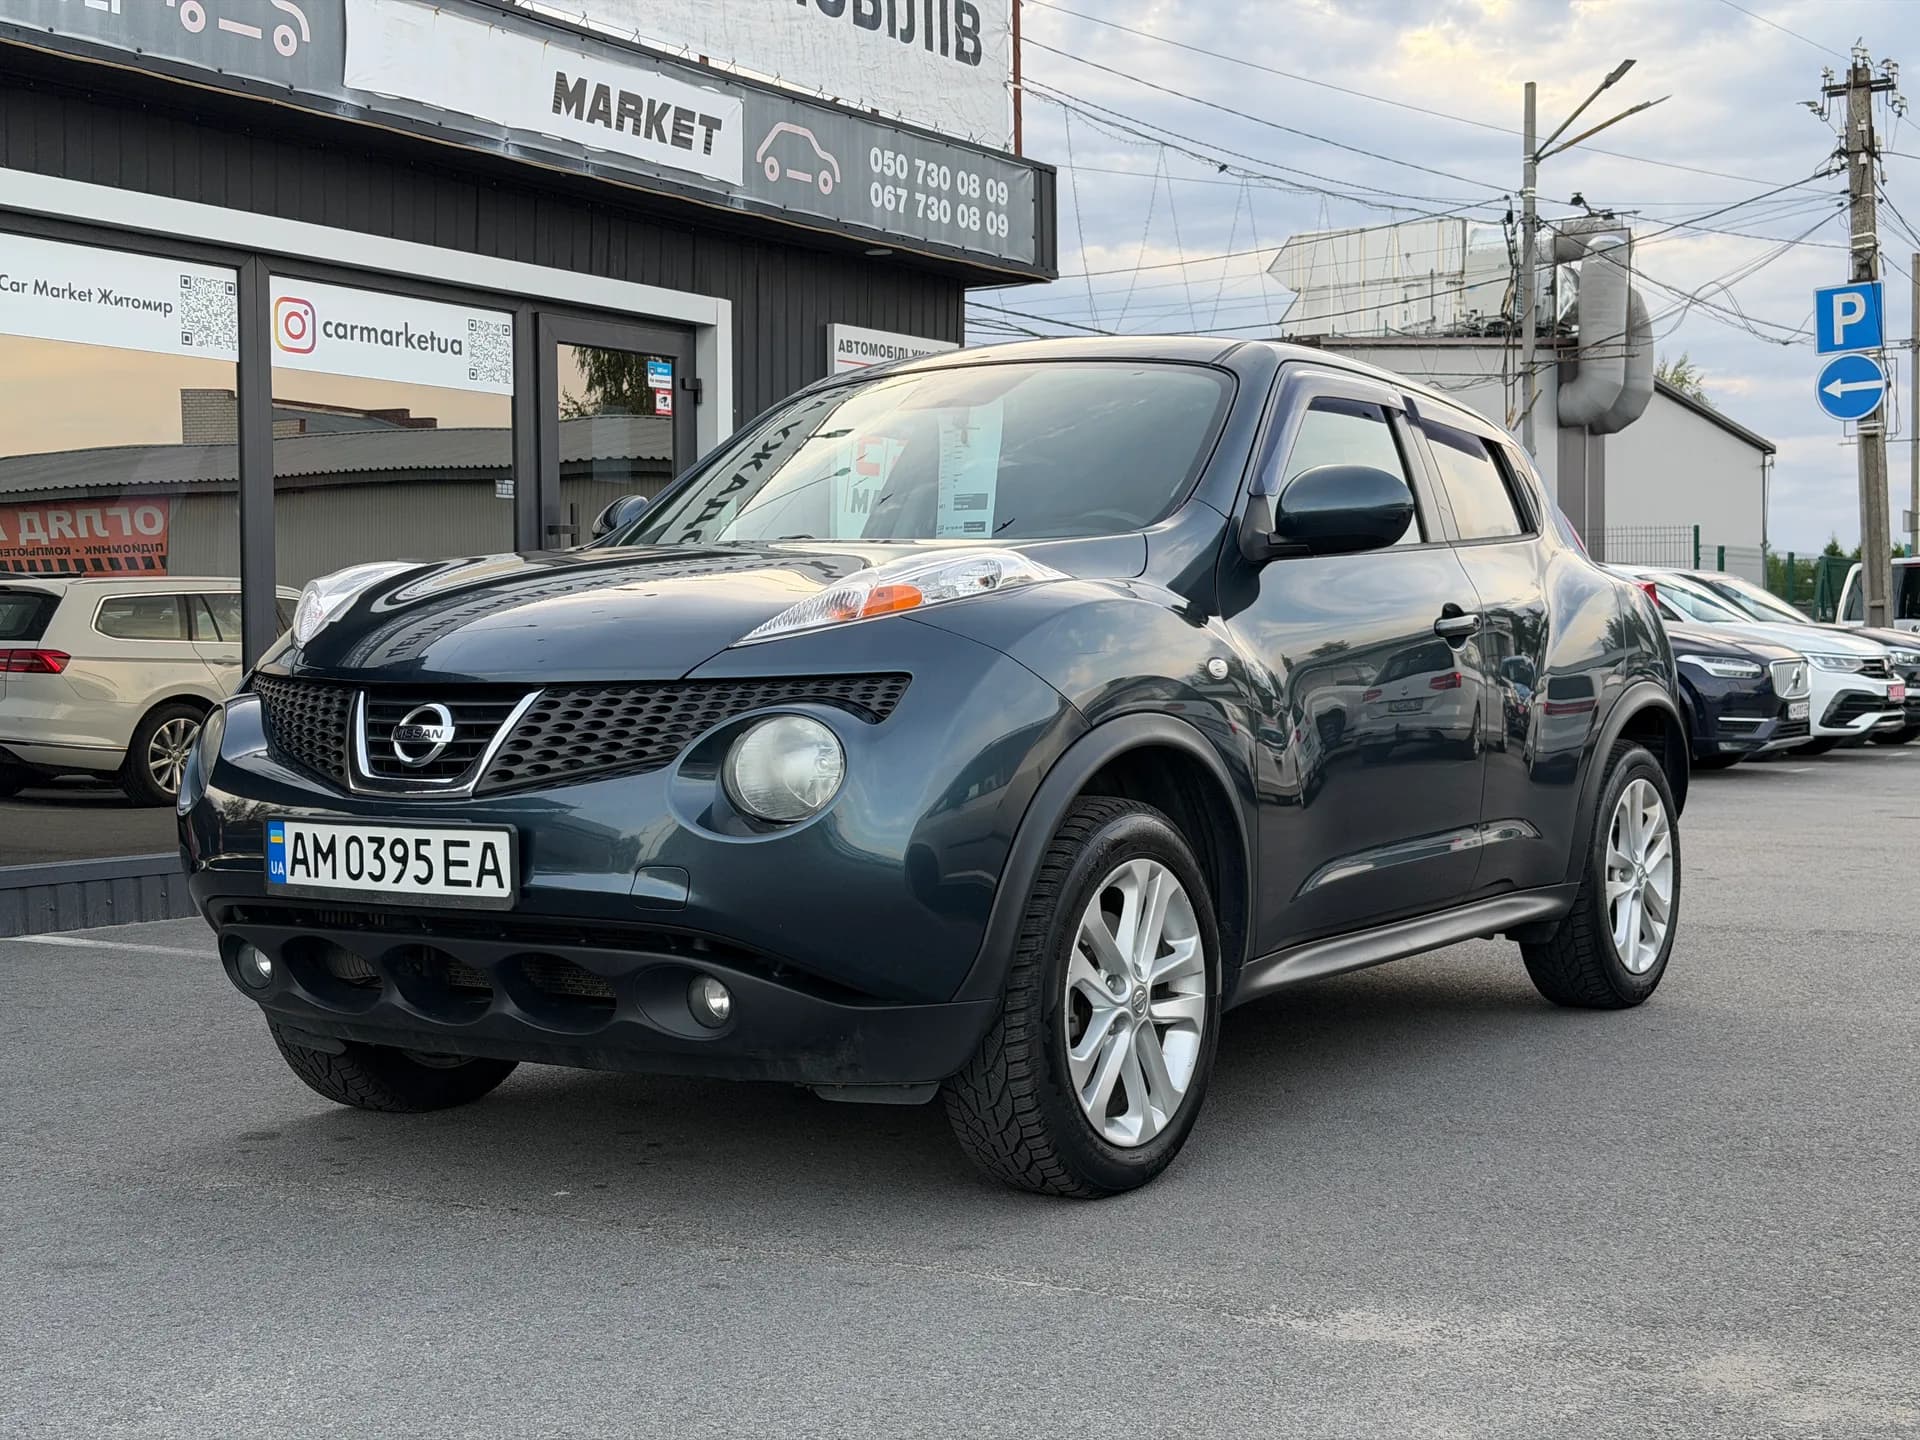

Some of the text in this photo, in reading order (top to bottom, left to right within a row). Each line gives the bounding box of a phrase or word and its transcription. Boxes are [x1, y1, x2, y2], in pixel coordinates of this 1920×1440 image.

[795, 0, 982, 66] ІЛІВ
[552, 71, 723, 155] MARKET
[870, 147, 1009, 206] 050 730 08 09
[870, 182, 1009, 238] 067 730 08 09
[0, 274, 173, 318] Car Market Житомир
[1832, 292, 1866, 345] P
[322, 320, 463, 356] carmarketua
[838, 338, 908, 360] АВТОМОБІЛІ
[393, 728, 444, 739] NISSAN
[271, 861, 285, 875] UA
